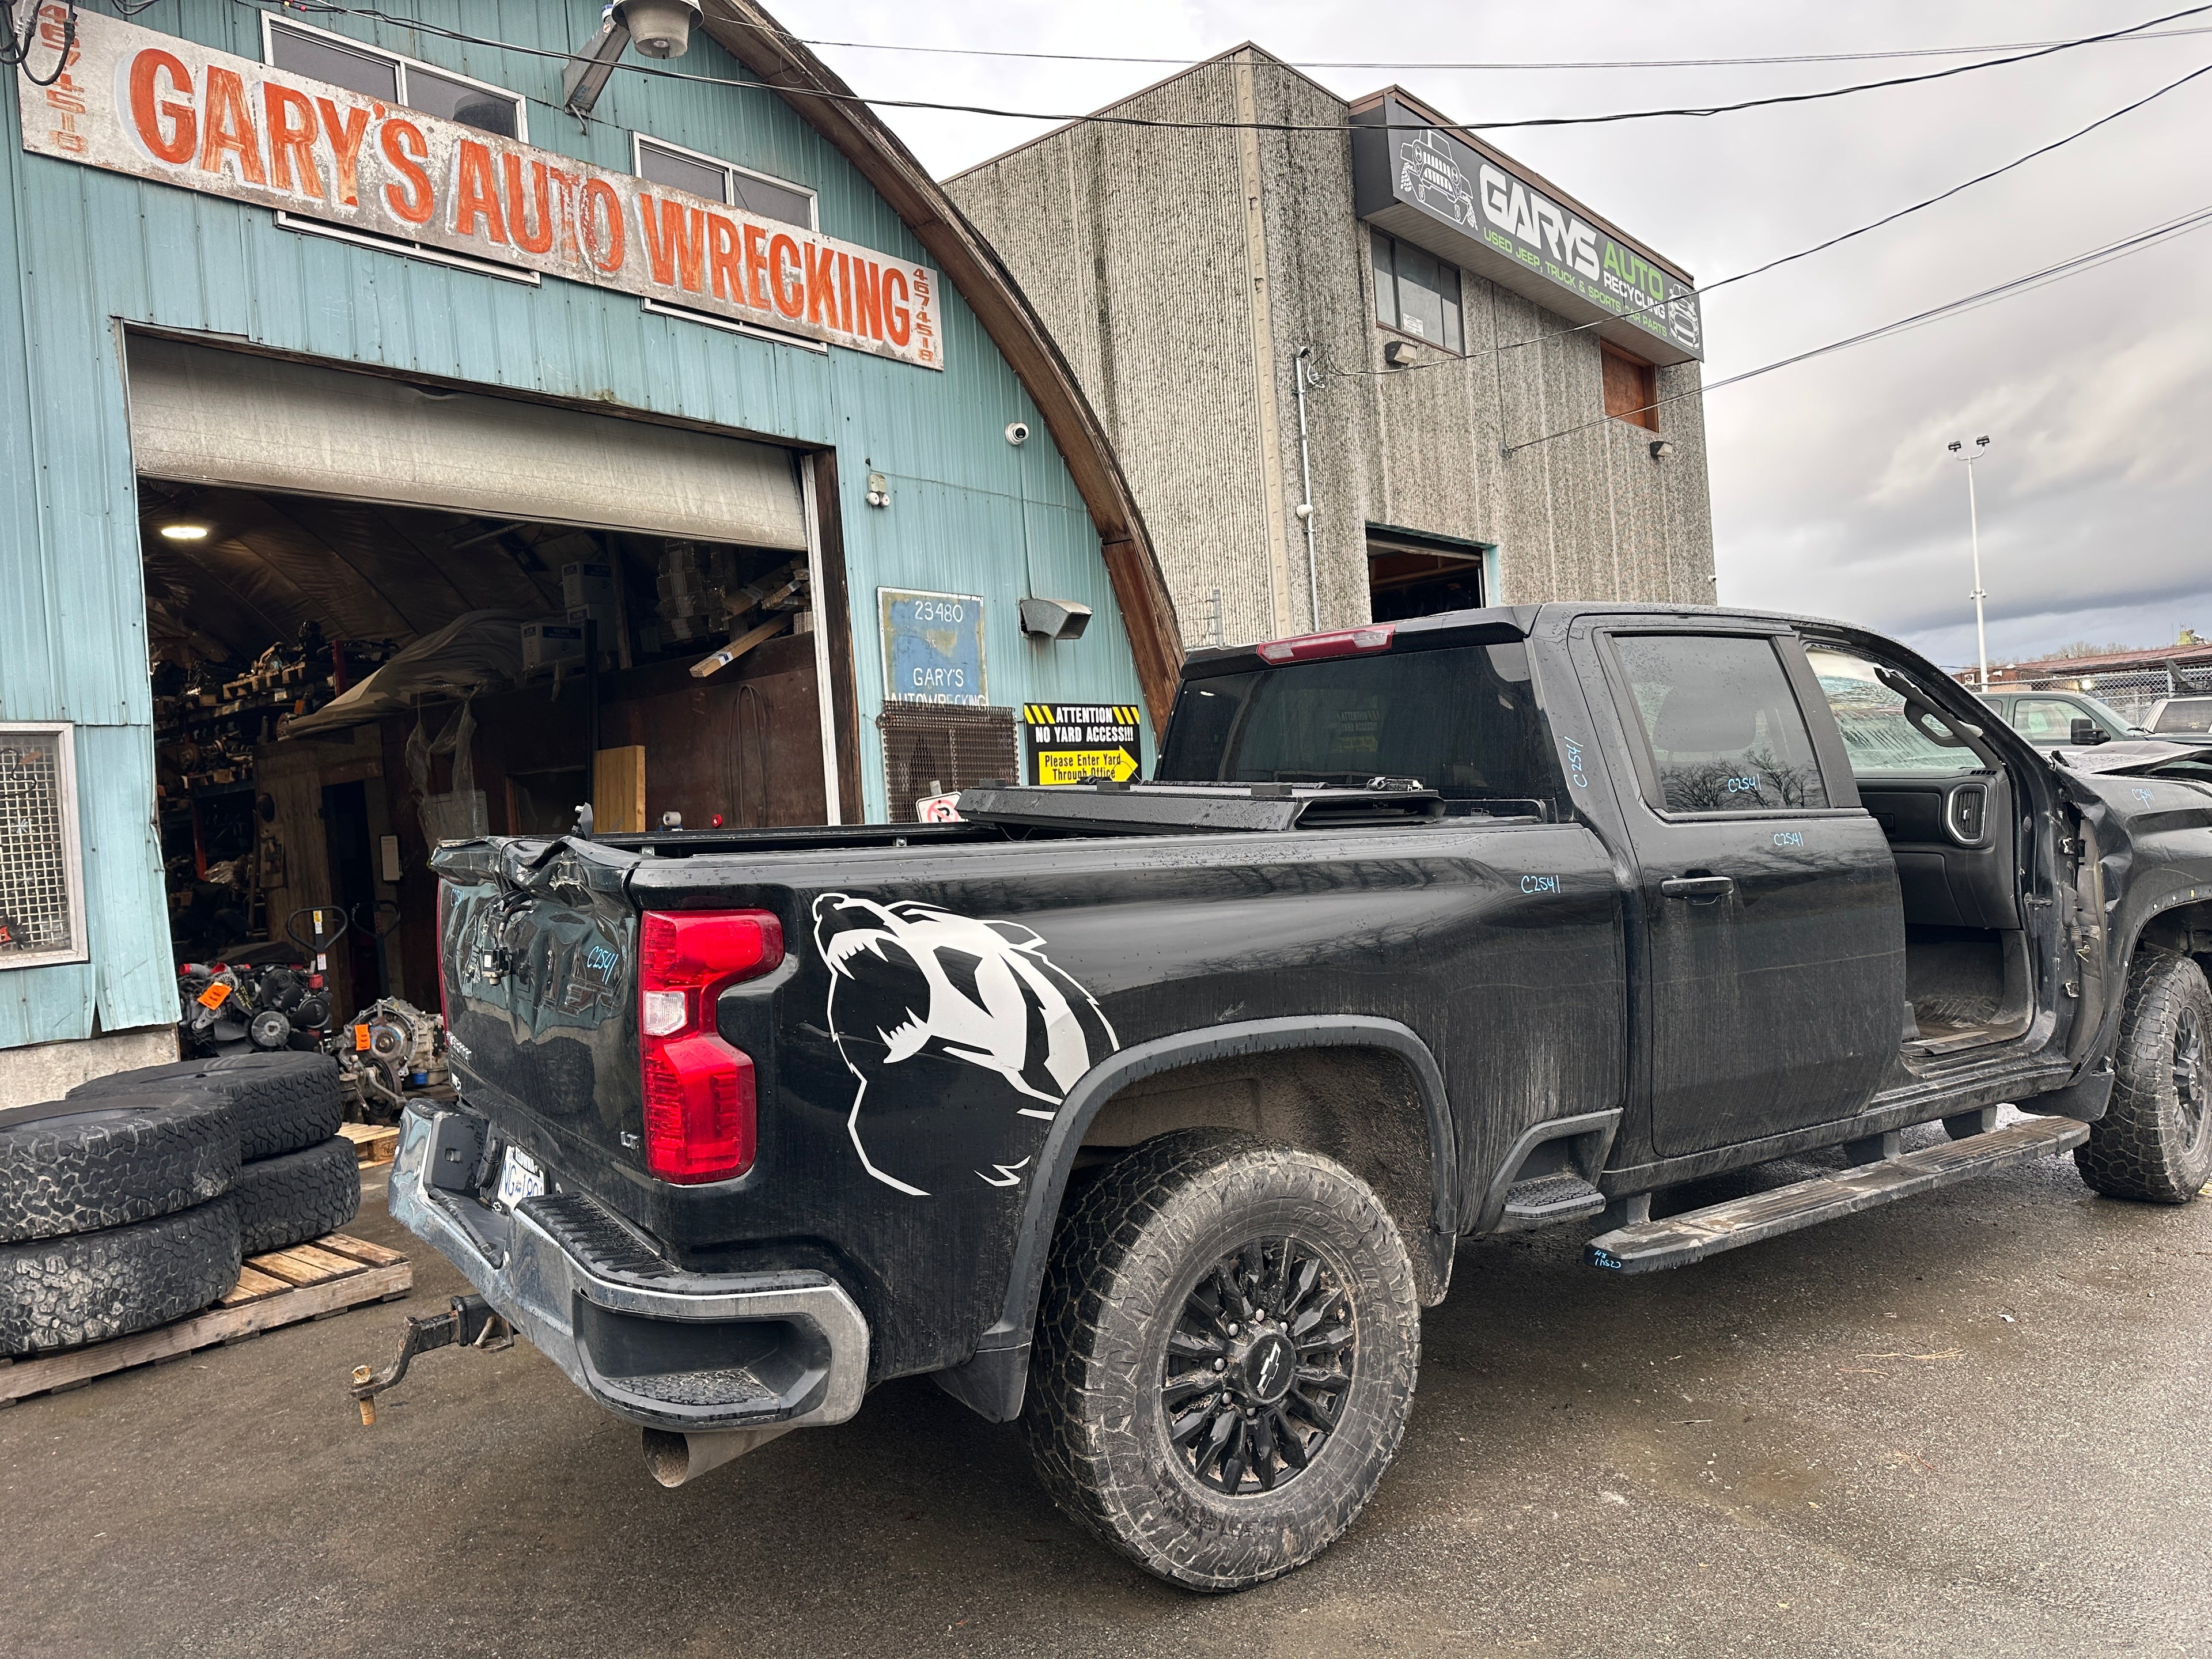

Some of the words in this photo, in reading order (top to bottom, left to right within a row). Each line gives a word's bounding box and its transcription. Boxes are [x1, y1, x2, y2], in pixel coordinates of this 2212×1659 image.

[128, 47, 434, 224] GARY'S
[456, 138, 624, 272] AUTO
[639, 193, 910, 347] WRECKING
[1479, 164, 1600, 282] GARYS
[1603, 241, 1664, 301] AUTO
[1483, 226, 1513, 254] USED
[1515, 247, 1543, 273] JEEP,
[1544, 260, 1577, 289] TRUCK
[1578, 279, 1586, 294] &
[1588, 285, 1622, 313] SPORTS
[1624, 305, 1641, 324] CAR
[1642, 315, 1668, 337] PARTS
[1603, 270, 1666, 319] RECYCLING
[914, 600, 963, 623] 23480
[913, 667, 964, 688] GARY'S
[1056, 706, 1113, 724] ATTENTION
[1035, 726, 1051, 743] NO
[1054, 726, 1082, 743] YARD
[1086, 726, 1134, 743] ACCESS!!!
[1045, 755, 1073, 767] Please
[1077, 753, 1100, 767] Enter
[1103, 753, 1121, 766] Yard
[1565, 736, 1588, 789] C2541
[1728, 773, 1762, 793] C2541
[1773, 831, 1804, 846] C2541
[1521, 874, 1560, 895] C2541
[586, 945, 618, 984] C2541
[620, 1131, 638, 1150] LT
[1292, 1205, 1360, 1249] TOYO
[1595, 1258, 1622, 1268] C2541
